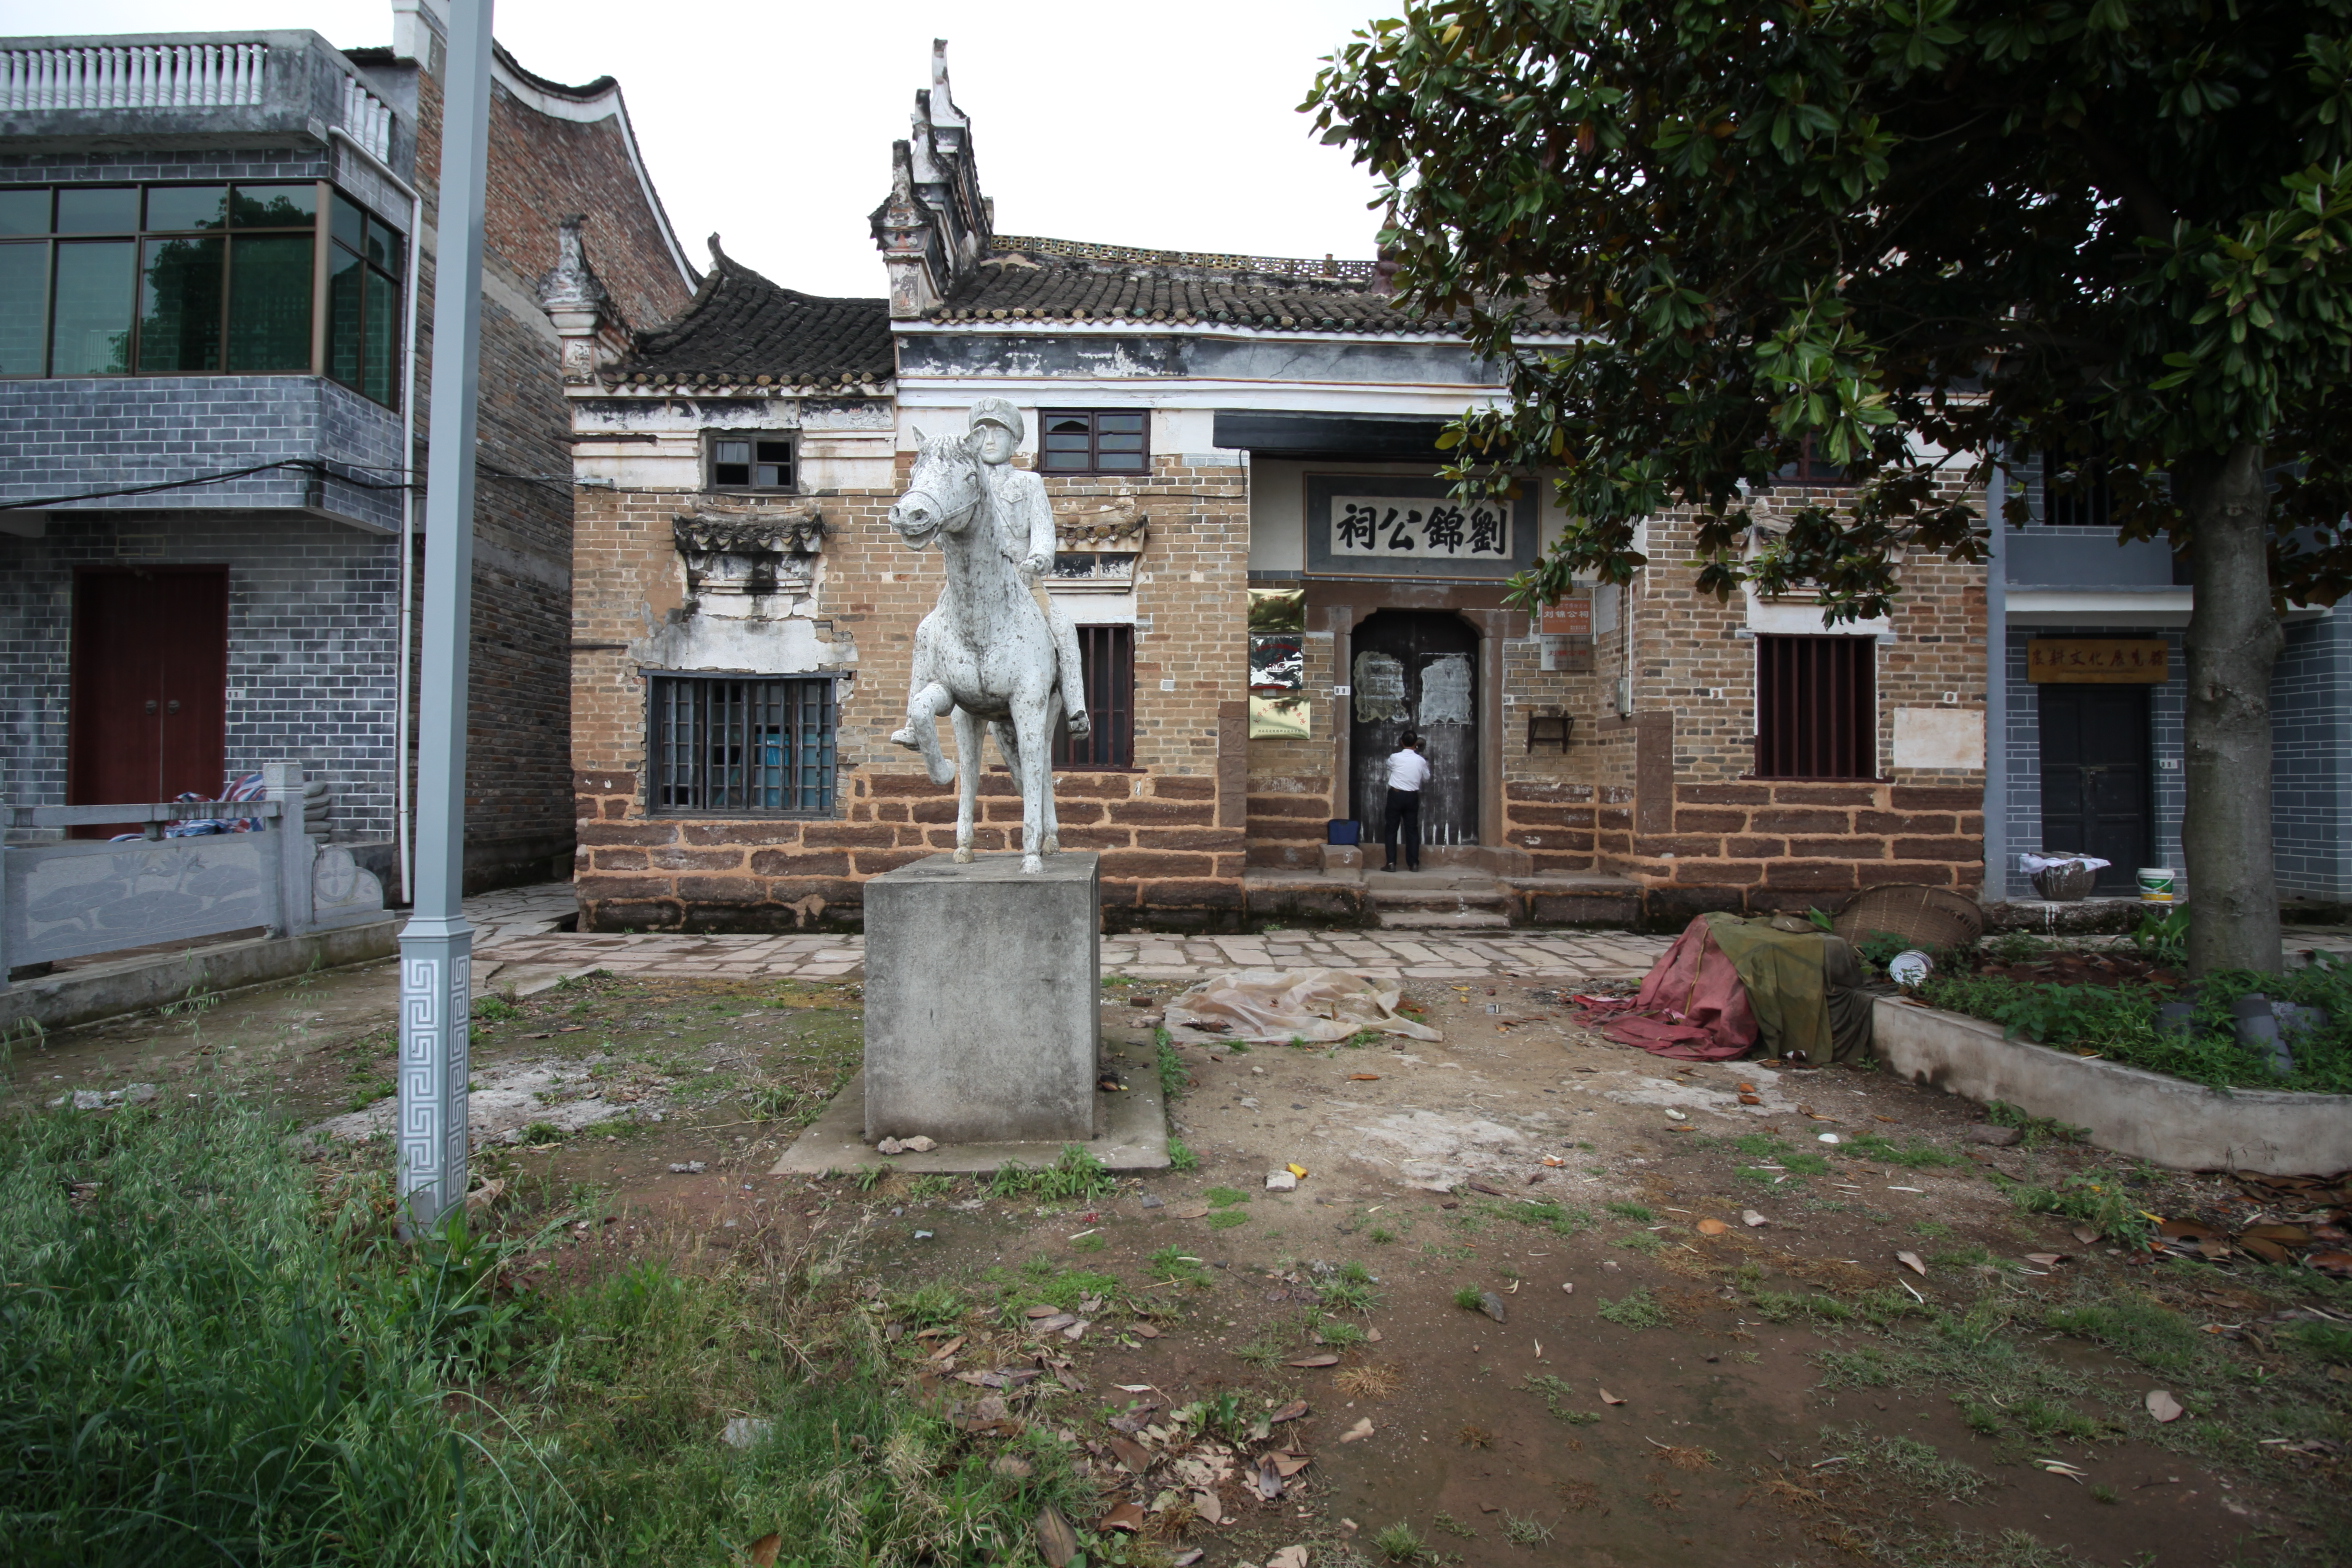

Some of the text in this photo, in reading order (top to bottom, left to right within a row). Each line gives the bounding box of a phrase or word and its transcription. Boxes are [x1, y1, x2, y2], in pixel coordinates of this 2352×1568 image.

[1336, 503, 1507, 555] 劉錦公祠
[1543, 610, 1589, 618] 刘锦公祠
